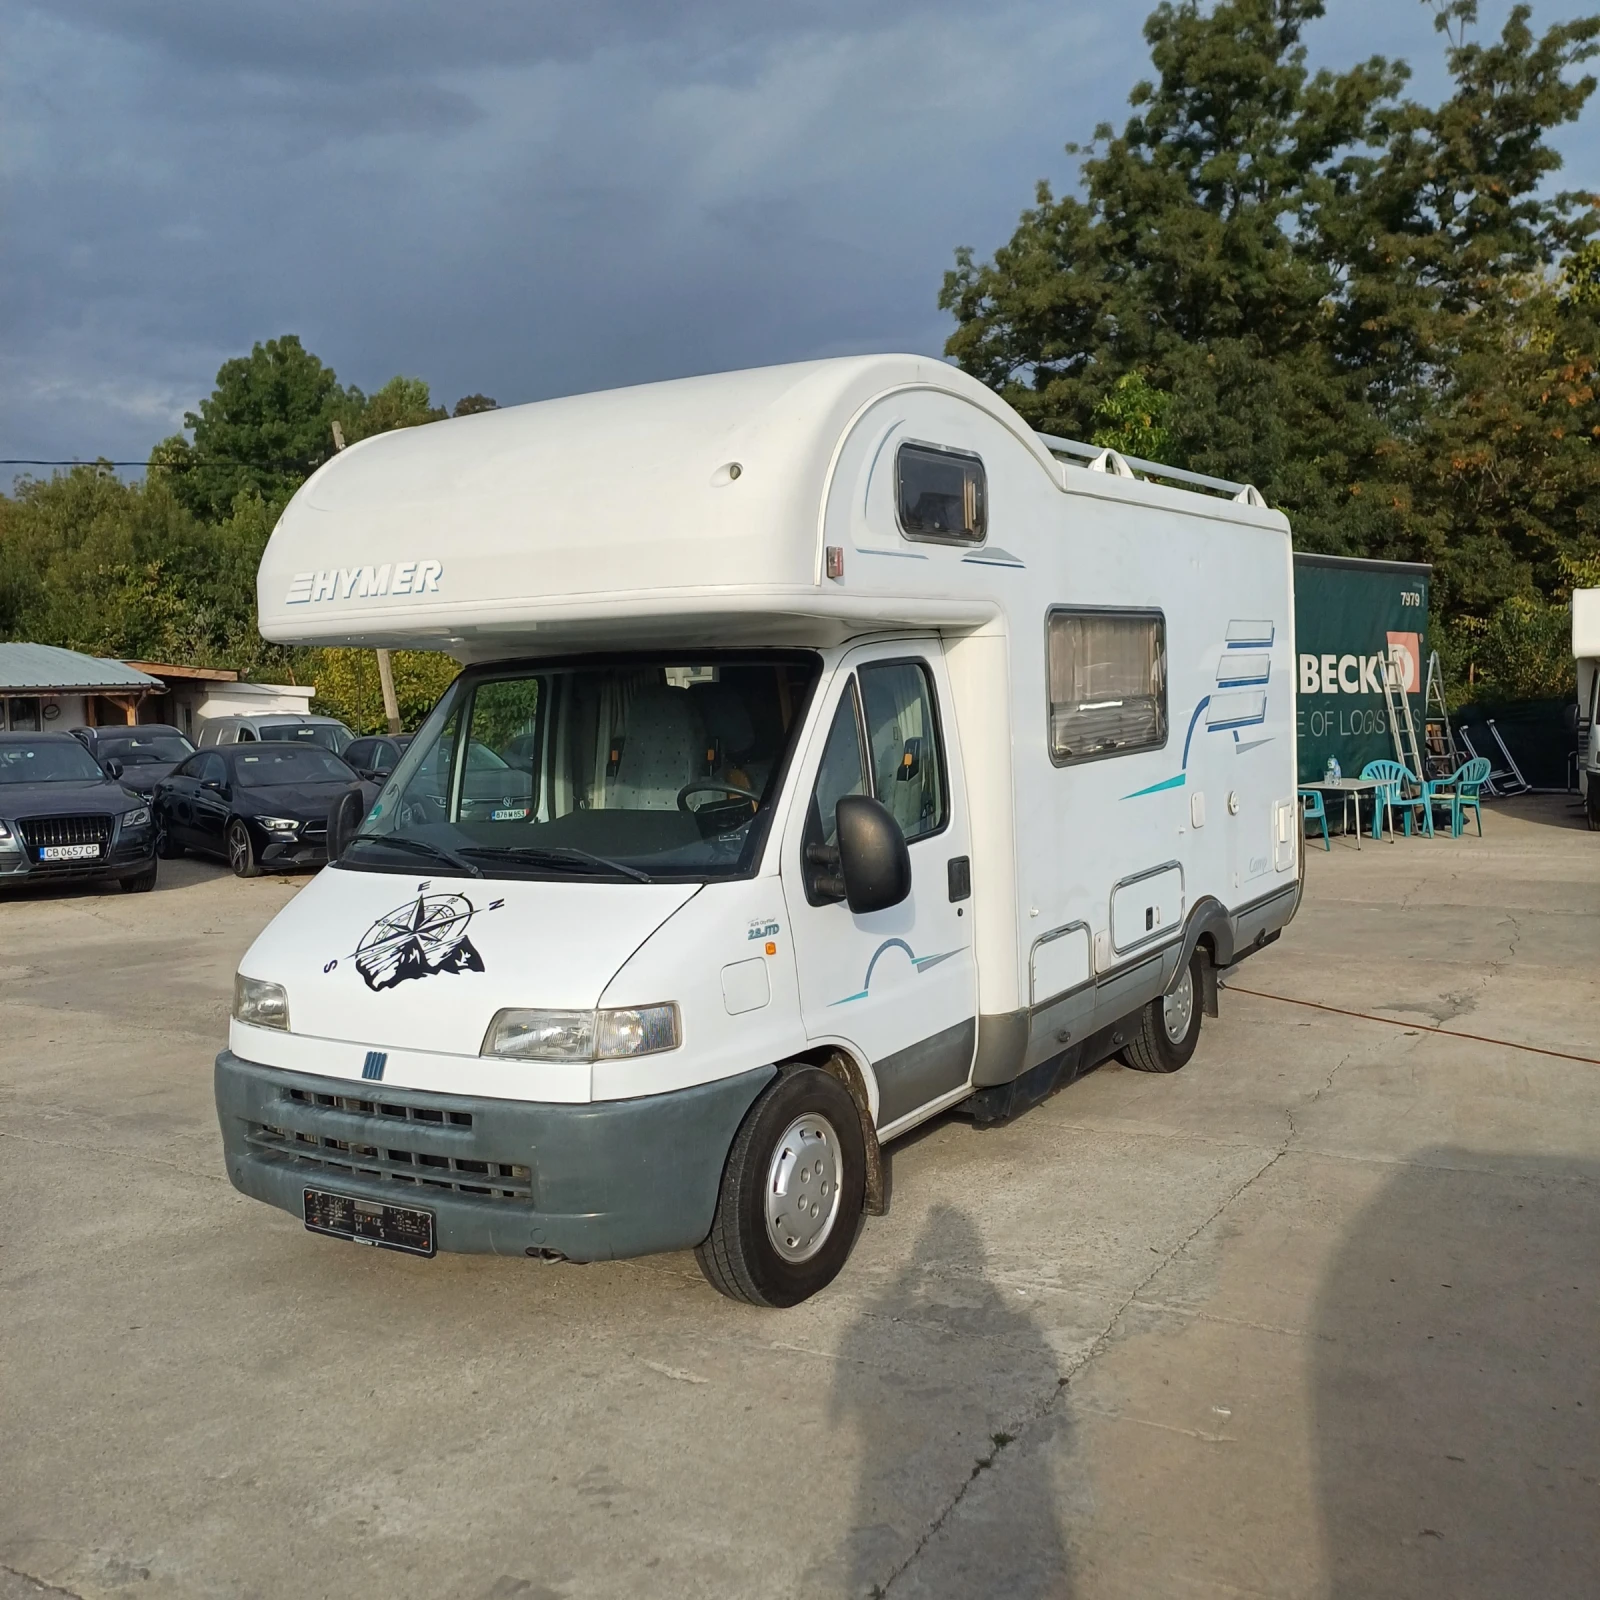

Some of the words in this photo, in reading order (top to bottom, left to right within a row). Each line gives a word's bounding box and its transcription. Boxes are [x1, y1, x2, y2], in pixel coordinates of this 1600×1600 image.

[313, 559, 443, 602] HYMER
[1400, 592, 1420, 607] 7979
[1310, 711, 1334, 737] OF
[46, 848, 60, 858] CB
[60, 846, 84, 857] 0657
[85, 845, 98, 855] CP
